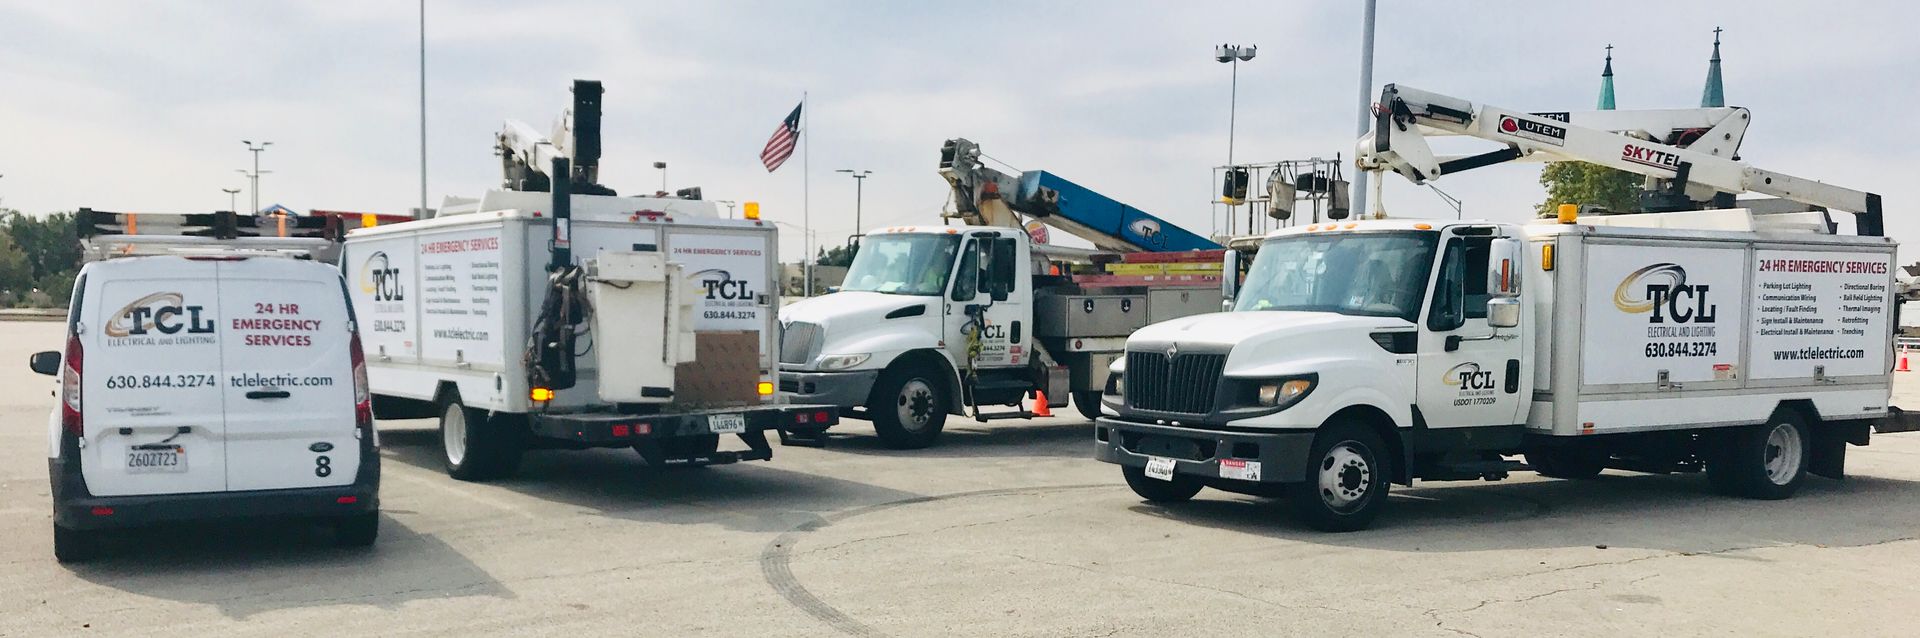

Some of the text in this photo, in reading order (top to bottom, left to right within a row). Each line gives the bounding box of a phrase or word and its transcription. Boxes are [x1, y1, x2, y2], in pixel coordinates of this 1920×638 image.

[1525, 122, 1561, 137] UTEM
[1622, 144, 1680, 167] SKYTEL
[471, 237, 498, 251] SERVICES
[693, 248, 732, 256] EMERGENCY
[1759, 259, 1887, 274] 24 HR EMERGENCY SERVICES
[372, 268, 404, 301] TCL
[702, 279, 753, 300] TCL
[1763, 282, 1782, 291] Parking
[1792, 282, 1812, 291] Lighting
[1844, 283, 1885, 292] Directional Boring
[1646, 284, 1716, 324] TCL
[1801, 294, 1817, 302] Wiring
[1863, 294, 1883, 302] Lighting
[255, 303, 299, 315] 24 HR
[703, 311, 756, 319] 630.844.3274
[946, 303, 952, 315] 2
[1761, 306, 1783, 314] Locating
[1799, 305, 1817, 314] Finding
[1862, 305, 1881, 313] Imaging
[124, 305, 215, 335] TCL
[232, 318, 321, 331] EMERGENCY
[1761, 317, 1772, 326] Sign
[1842, 316, 1869, 325] Retrofitting
[983, 325, 1005, 338] CL
[1647, 326, 1716, 338] ELECTRICAL AND LIGHTING
[1760, 328, 1783, 336] Electrical
[1842, 328, 1864, 336] Trenching
[107, 338, 156, 347] ELECTRICAL
[175, 336, 216, 345] LIGHTING
[245, 335, 312, 346] SERVICES
[1645, 342, 1717, 357] 630.844.3274
[1773, 346, 1864, 360] www.tclelectric.com
[106, 375, 216, 389] 630.844.3274
[231, 372, 333, 387] tclelectric.com
[1459, 371, 1495, 390] TCL
[1473, 397, 1497, 405] 1770209
[315, 455, 331, 477] 8
